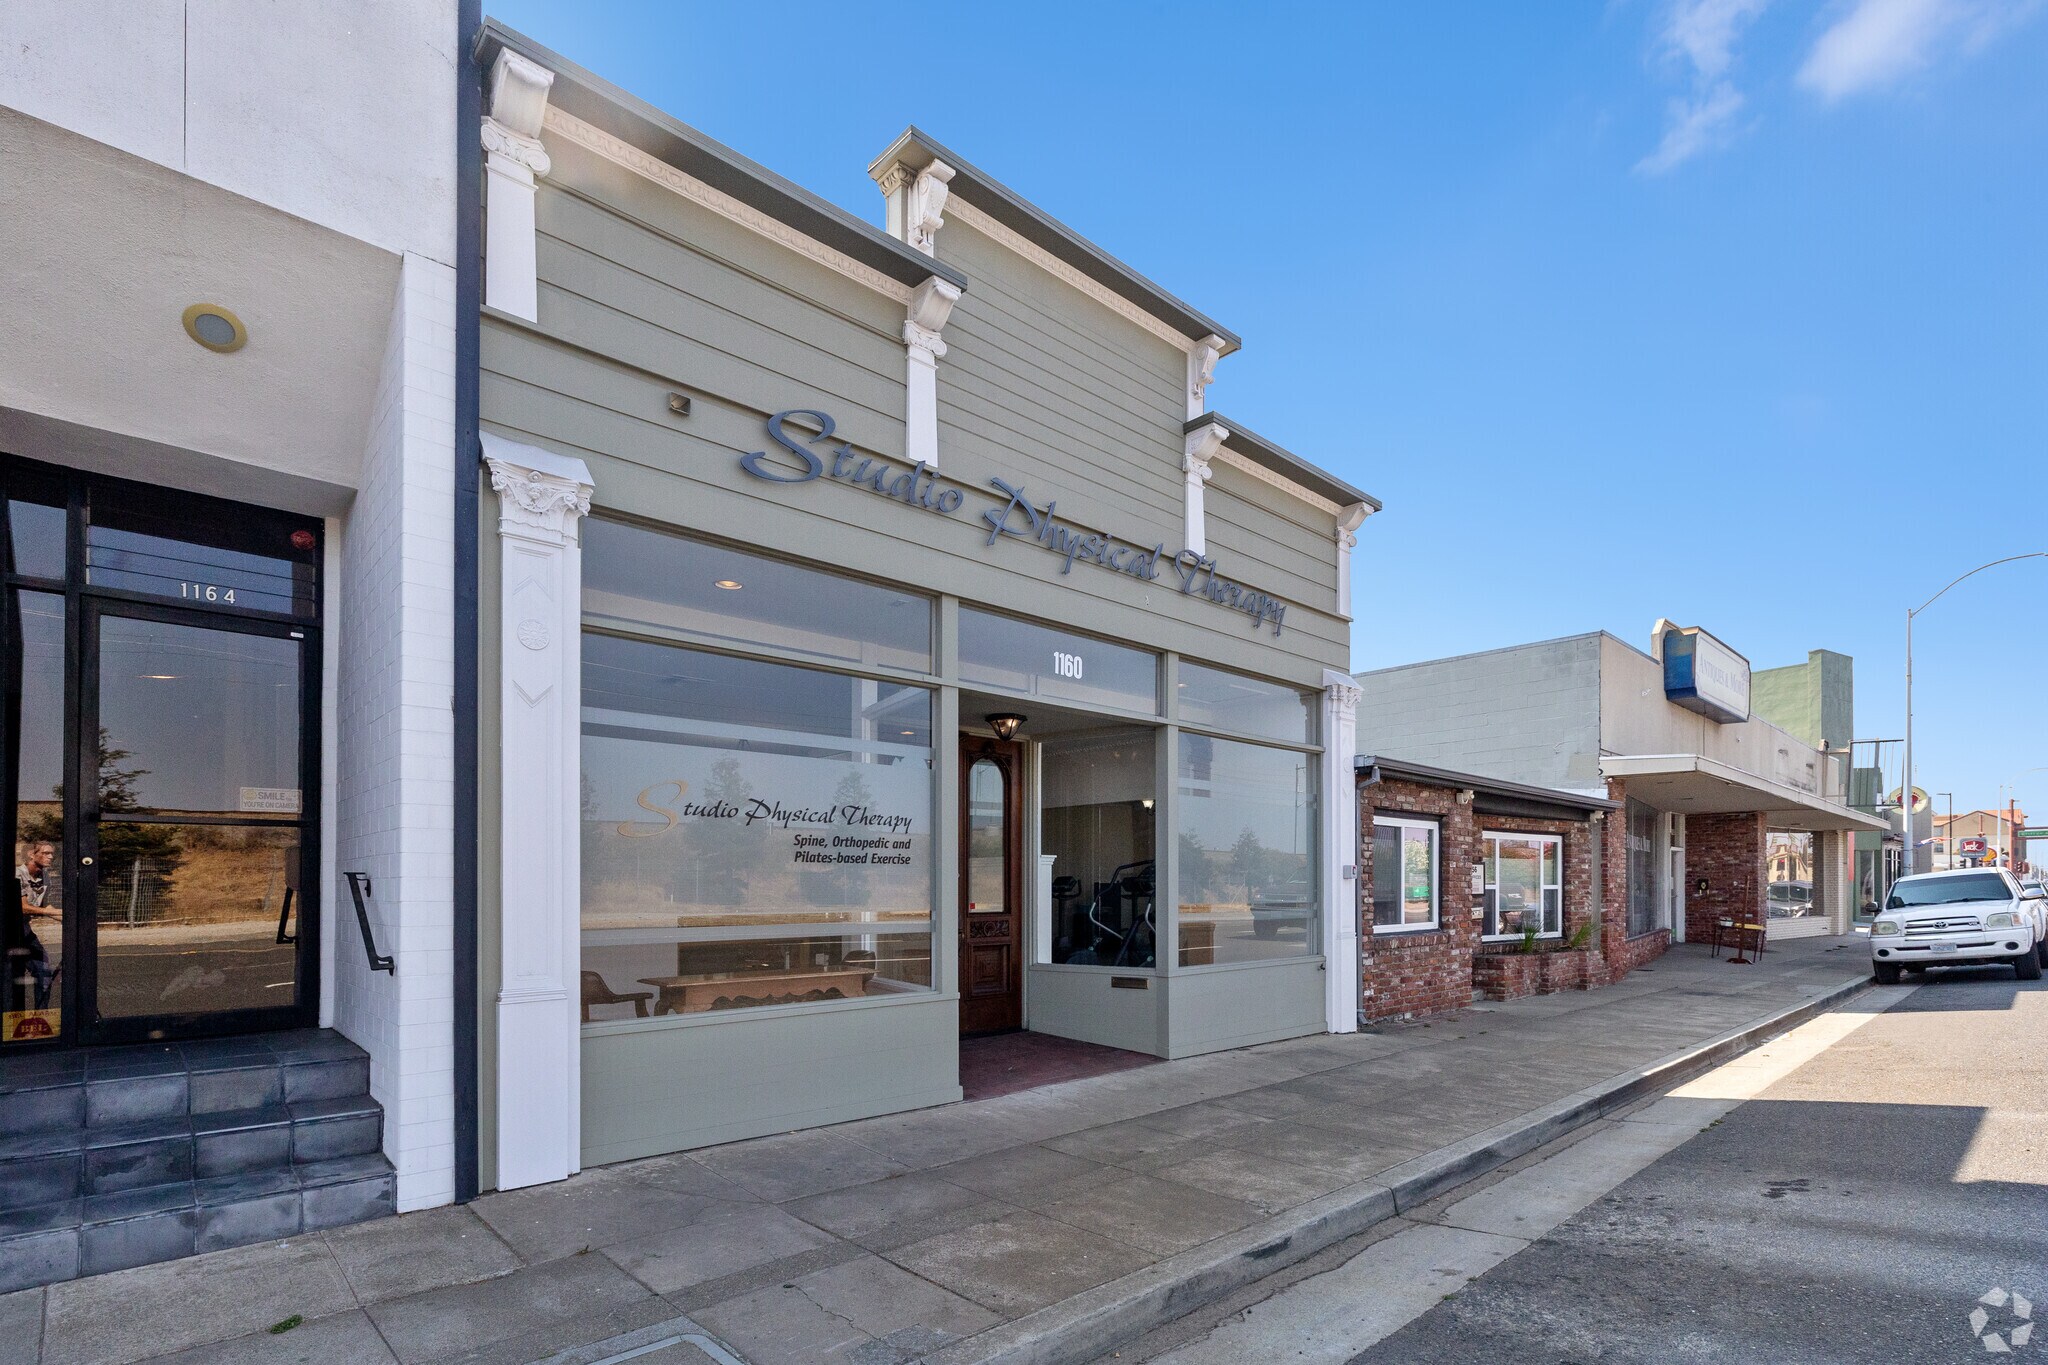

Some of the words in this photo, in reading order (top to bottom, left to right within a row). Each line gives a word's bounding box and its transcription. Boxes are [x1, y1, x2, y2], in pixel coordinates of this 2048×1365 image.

[739, 409, 965, 513] Studio
[982, 476, 1163, 576] Physical
[1174, 548, 1288, 637] Therapy
[181, 582, 236, 604] 1164
[1053, 651, 1083, 680] 1160
[258, 791, 286, 801] SMILE
[265, 801, 275, 809] ON
[616, 780, 739, 838] Studio
[745, 797, 837, 829] Physical
[841, 805, 912, 834] Therapy
[793, 834, 828, 849] Spine,
[832, 835, 890, 851] Orthopedic
[892, 838, 911, 850] and
[794, 851, 868, 864] Pilates-based
[871, 853, 911, 865] Exercise
